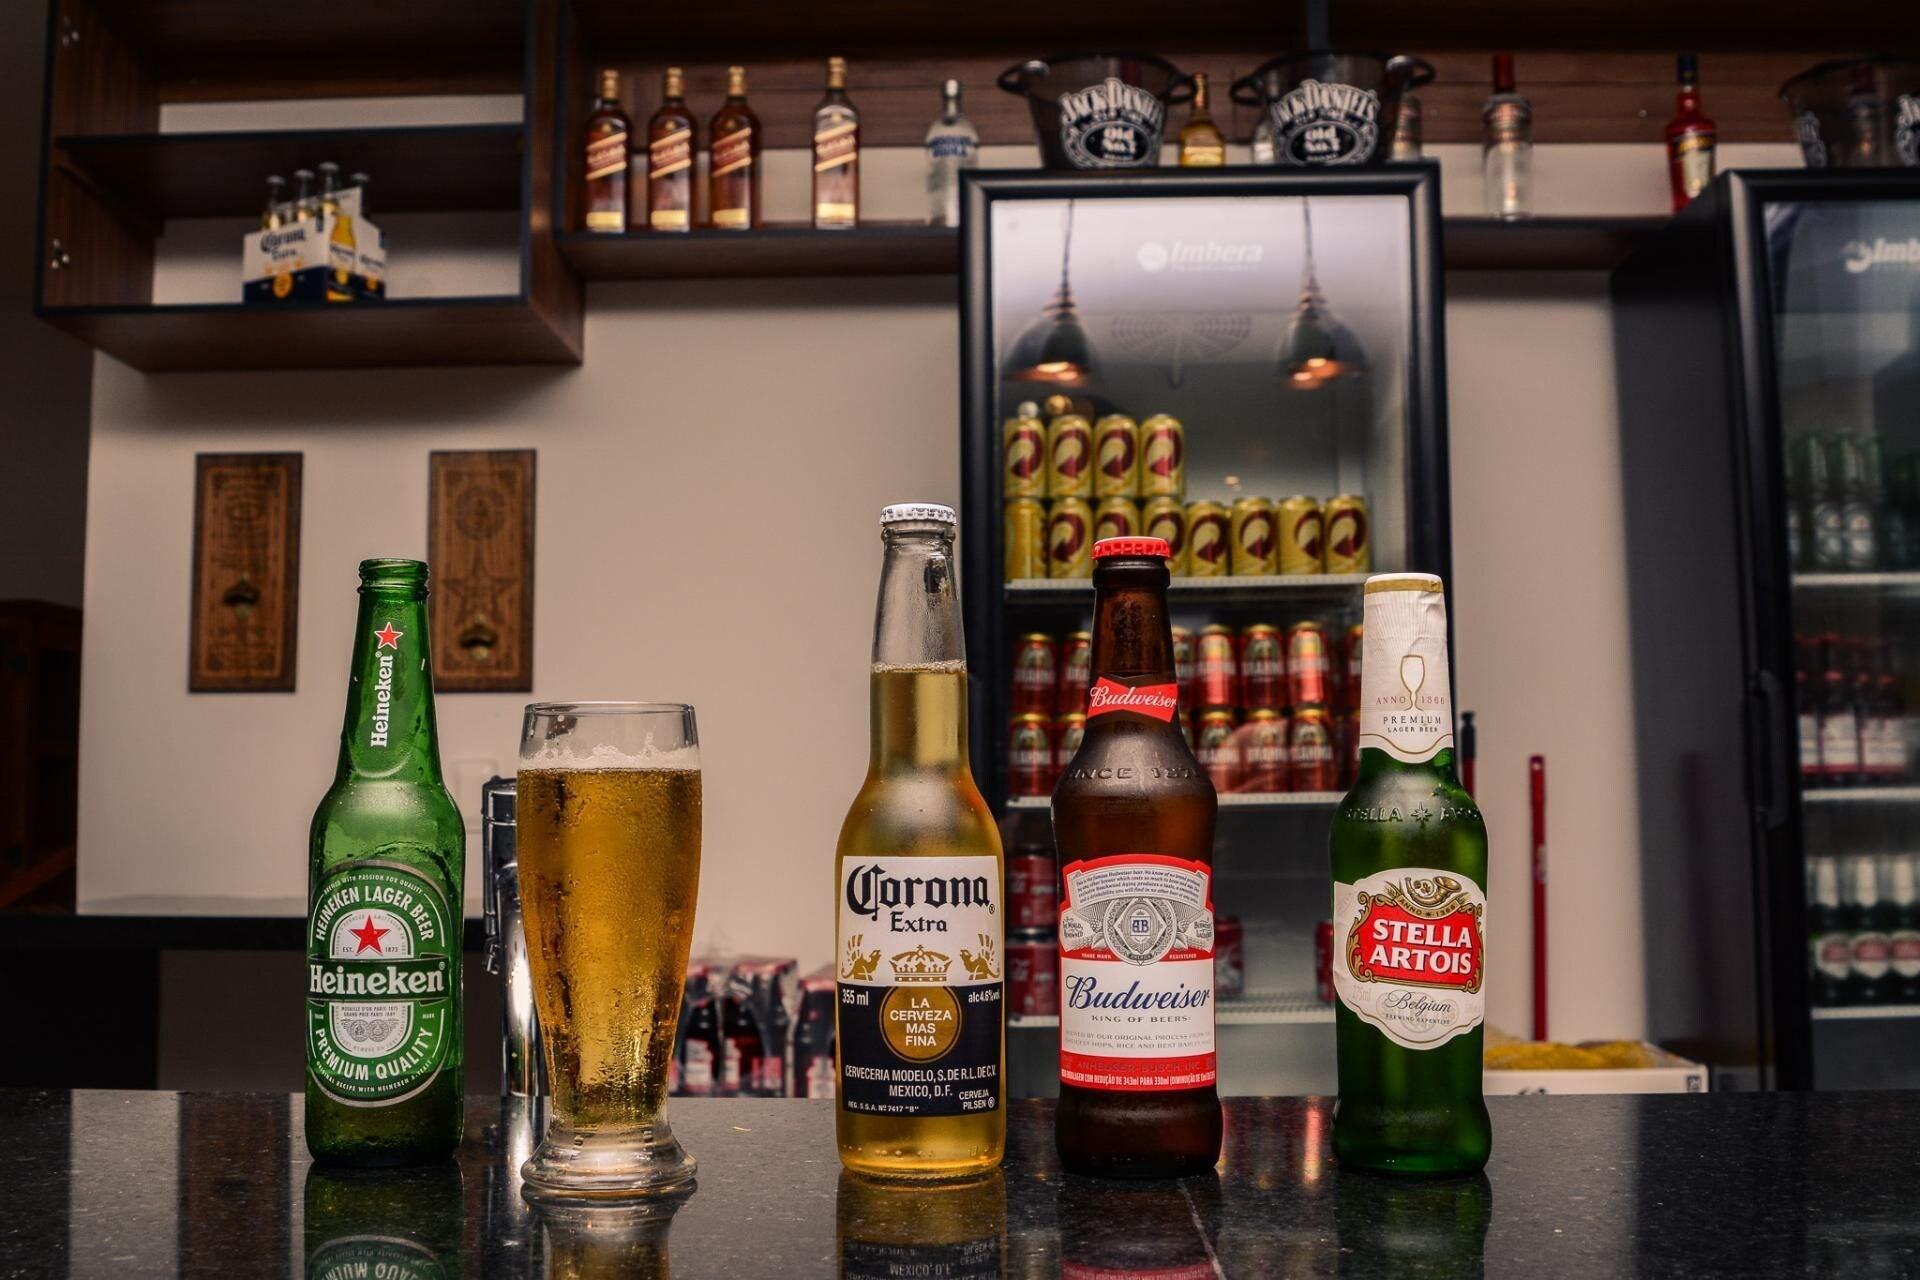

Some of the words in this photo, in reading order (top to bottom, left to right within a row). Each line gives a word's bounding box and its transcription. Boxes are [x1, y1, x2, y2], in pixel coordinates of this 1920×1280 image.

[370, 652, 394, 748] Heineken
[1089, 685, 1177, 707] Budweiser
[1376, 695, 1406, 705] ANNO
[1383, 715, 1441, 725] PREMIUM
[399, 879, 423, 894] QUALITY
[846, 863, 990, 922] Corona
[315, 886, 360, 942] HEINEKEN
[365, 885, 413, 911] LAGER
[409, 903, 435, 942] BEER
[890, 911, 948, 932] Extra
[1372, 918, 1472, 949] STELLA
[1369, 944, 1472, 975] ARTOIS
[309, 964, 445, 995] Heineken
[842, 988, 855, 1004] 355
[856, 991, 869, 1006] ml
[1065, 975, 1210, 1010] Budweiser
[911, 997, 930, 1009] LA
[1384, 988, 1452, 1017] Belgium
[890, 1010, 952, 1021] CERVEZA
[1091, 1015, 1121, 1023] KING
[1127, 1015, 1145, 1023] OF
[906, 1022, 936, 1034] MAS
[905, 1035, 937, 1046] FINA
[1096, 1033, 1112, 1041] OUR
[1114, 1034, 1153, 1042] ORIGINAL
[315, 1028, 369, 1081] PREMIUM
[375, 1027, 433, 1079] QUALITY
[845, 1064, 890, 1081] CERVECERIA
[892, 1069, 937, 1083] MODELO,
[947, 1068, 960, 1081] DE
[1139, 1076, 1154, 1086] PARA
[889, 1084, 932, 1099] MEXICO,
[934, 1084, 953, 1097] D.F.
[958, 1088, 990, 1100] CERVEJA
[963, 1099, 987, 1110] PILSEN
